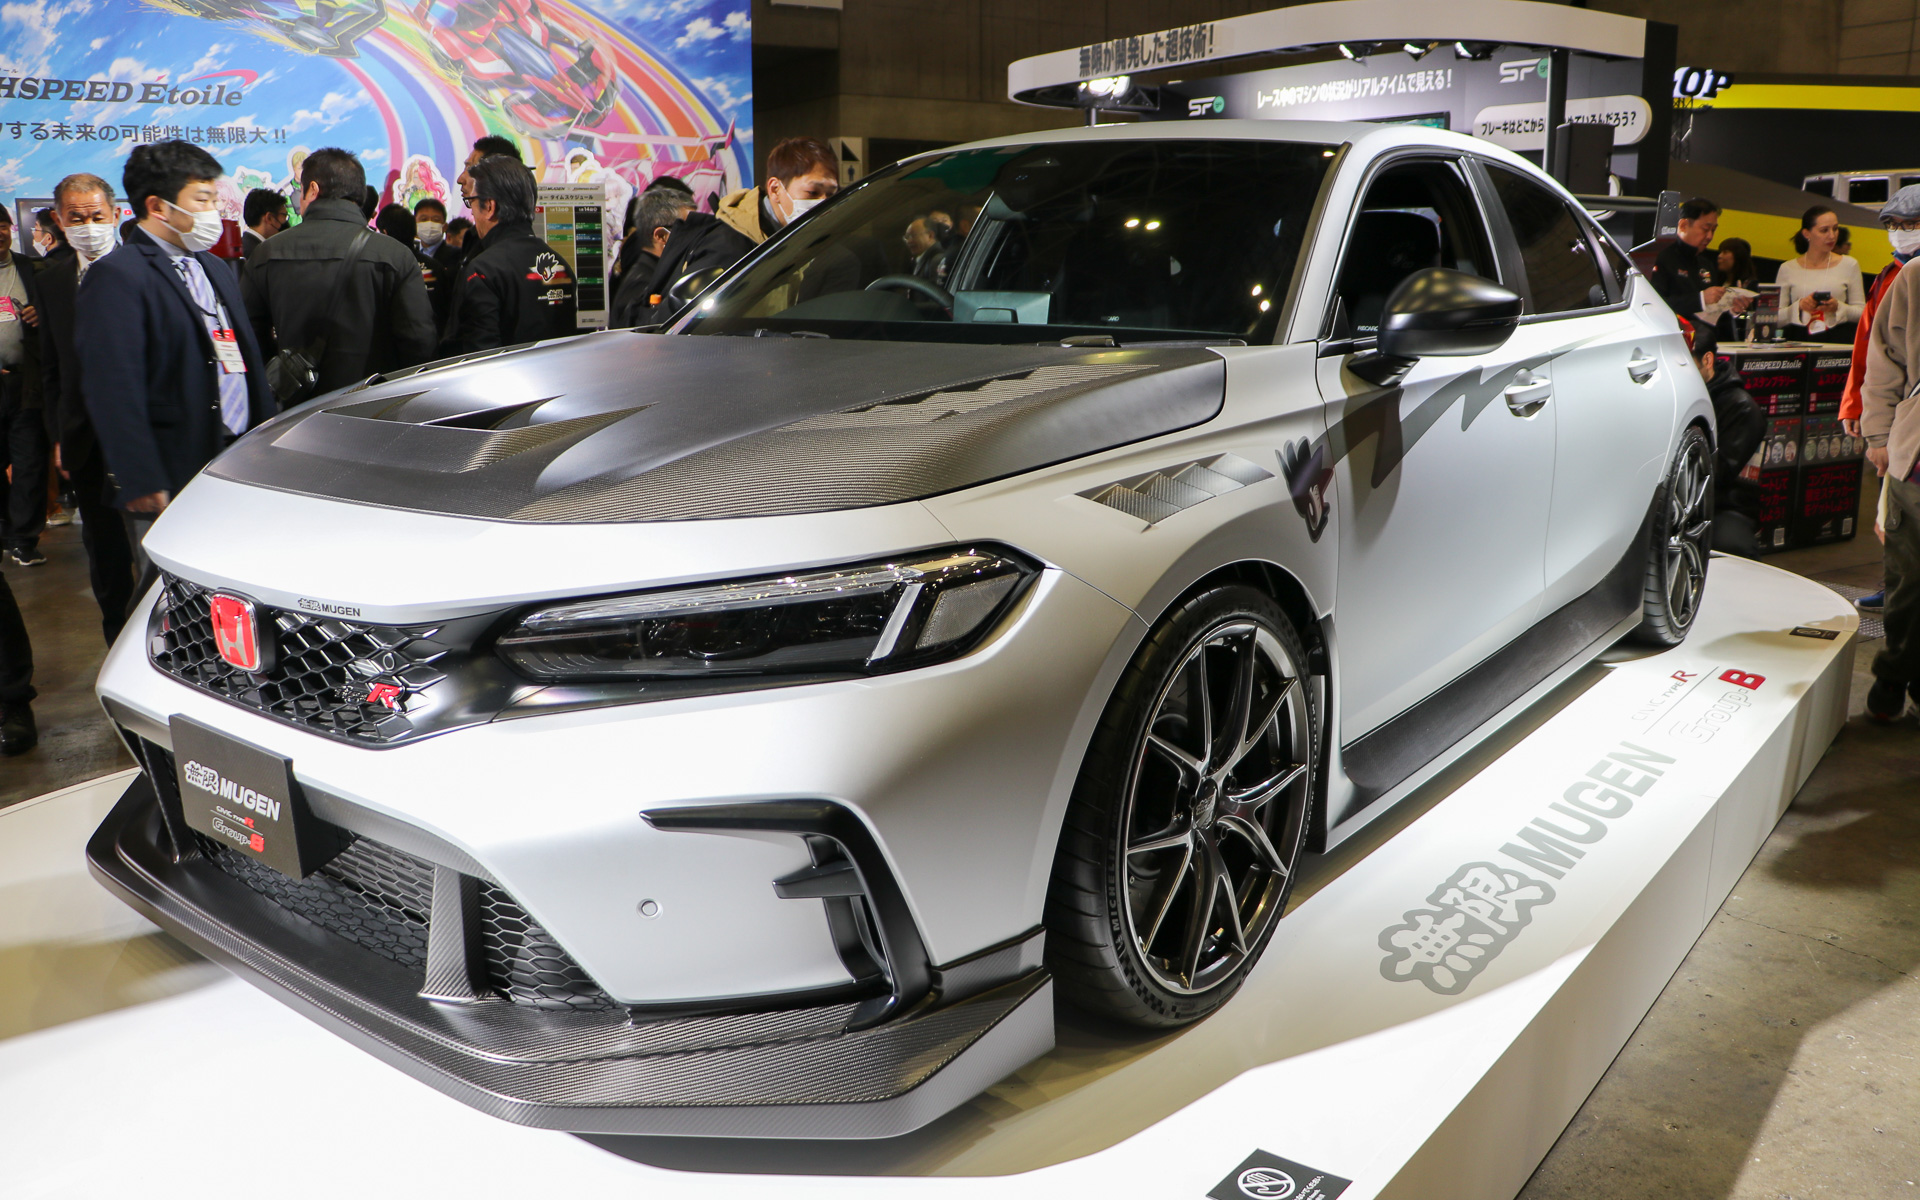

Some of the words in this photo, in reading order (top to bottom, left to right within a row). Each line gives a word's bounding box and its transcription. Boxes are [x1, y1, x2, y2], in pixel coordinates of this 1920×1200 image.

[137, 74, 243, 107] Étoile
[0, 121, 287, 144] する未来の可能性は無限大!!
[322, 603, 361, 616] MUGEN
[184, 760, 219, 795] 無限
[219, 776, 281, 822] MUGEN
[1378, 861, 1556, 995] 無限
[1498, 740, 1677, 881] MUGEN
